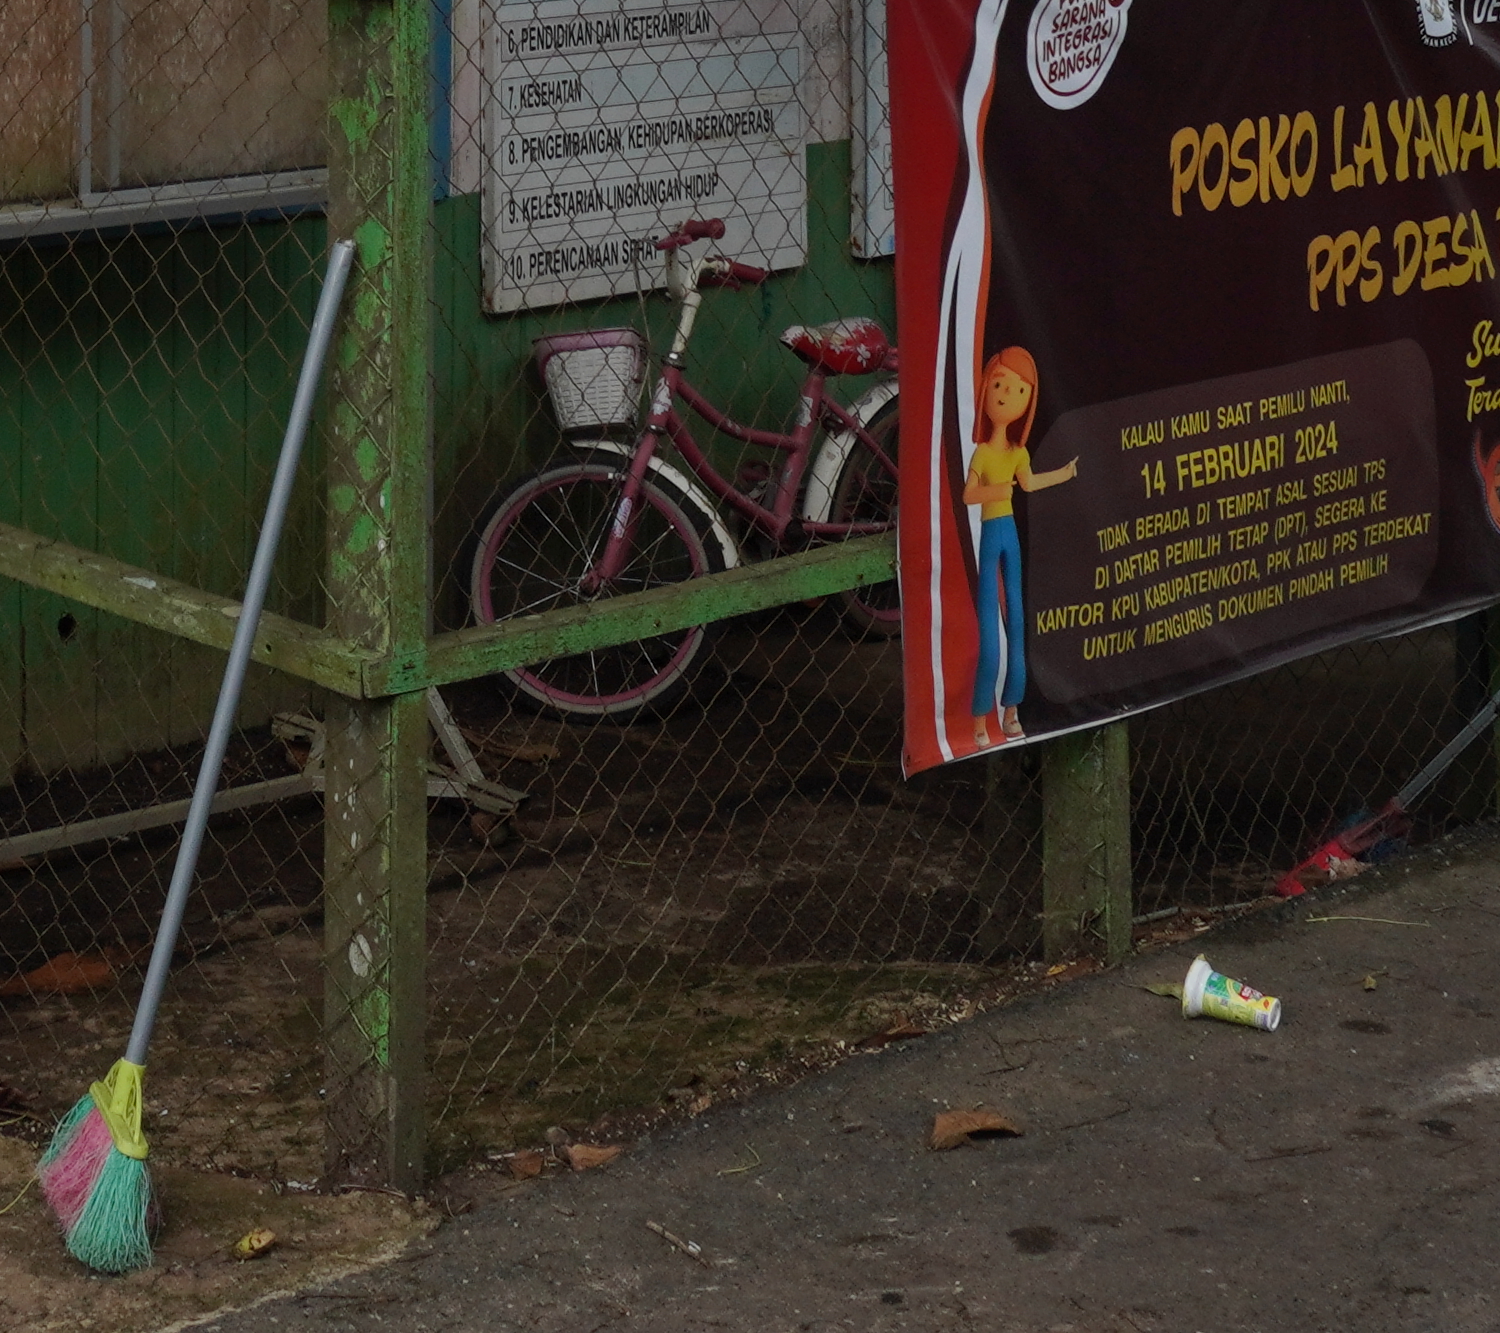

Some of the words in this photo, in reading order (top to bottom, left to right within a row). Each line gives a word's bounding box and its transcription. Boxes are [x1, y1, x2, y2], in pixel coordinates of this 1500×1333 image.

[1043, 18, 1112, 61] INTEGRASI
[1050, 44, 1101, 83] BANGSA
[1170, 111, 1318, 216] POSKO
[1307, 226, 1383, 311] PPS
[1393, 209, 1495, 295] DESA
[1122, 420, 1164, 450] KALAU
[1171, 410, 1209, 439] KAMU
[1217, 402, 1252, 429] SAAT
[1260, 390, 1305, 420] PEMILU
[1141, 460, 1166, 498] 14
[1176, 434, 1284, 491] FEBRUARI
[1295, 421, 1338, 463] 2024
